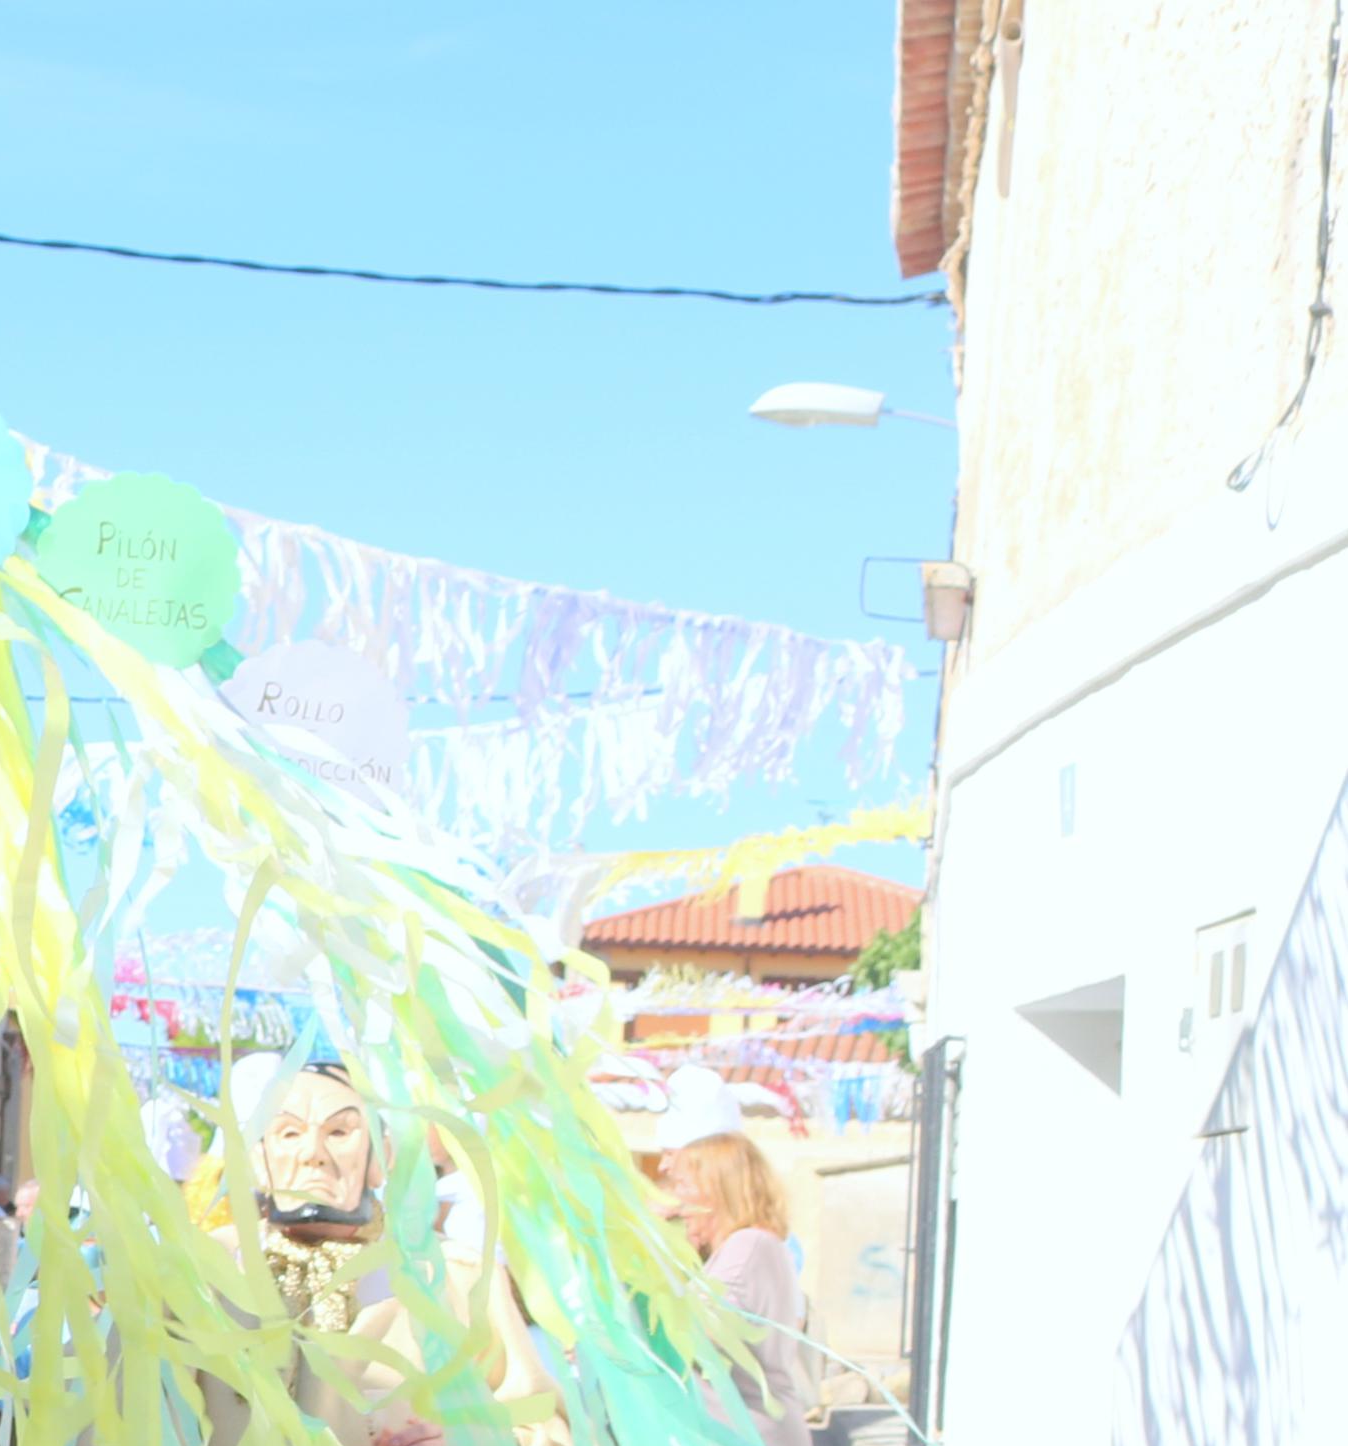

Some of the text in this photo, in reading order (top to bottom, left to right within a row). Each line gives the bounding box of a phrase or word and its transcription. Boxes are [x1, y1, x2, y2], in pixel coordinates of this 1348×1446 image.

[97, 521, 177, 561] PILÓN
[116, 567, 146, 589] DE
[257, 681, 344, 724] ROLLO
